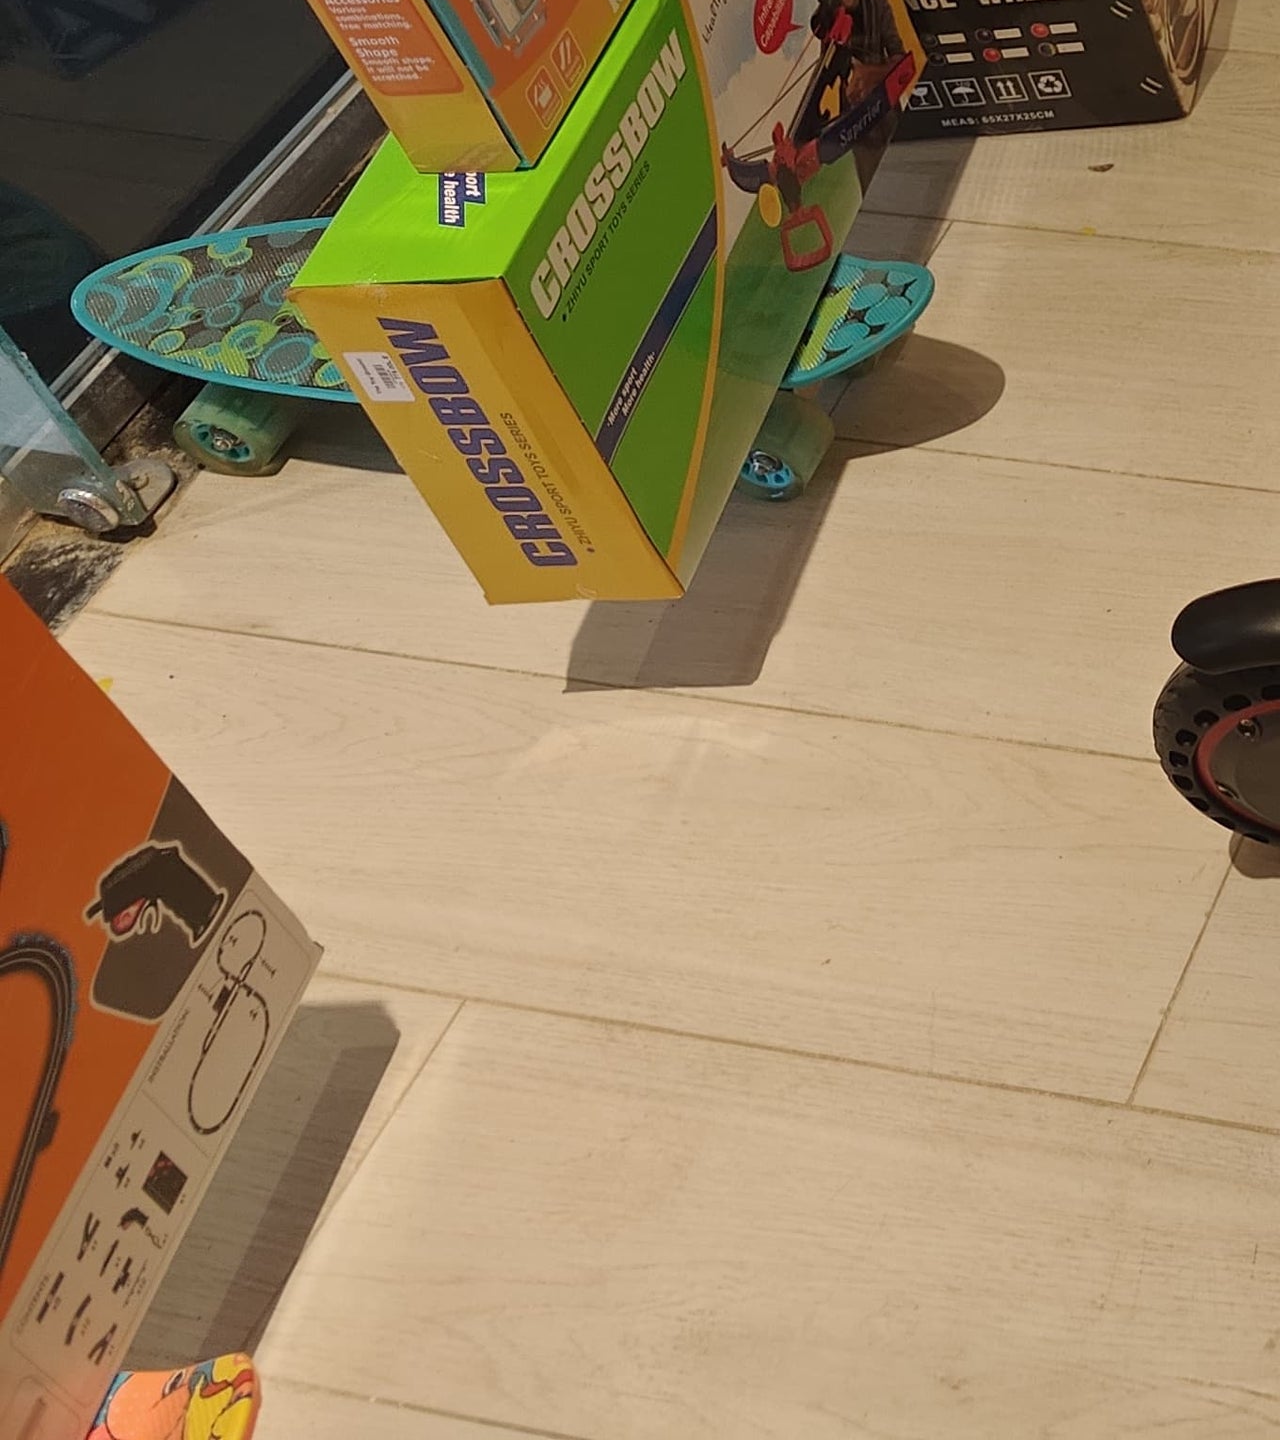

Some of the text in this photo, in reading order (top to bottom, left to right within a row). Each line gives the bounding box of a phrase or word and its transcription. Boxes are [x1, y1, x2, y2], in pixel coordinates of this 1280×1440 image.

[349, 36, 400, 46] Smooth
[355, 48, 398, 58] Shape
[838, 99, 884, 148] Superior
[941, 116, 979, 128] MEAS:
[530, 31, 689, 322] CROSSBOW
[443, 180, 460, 223] health
[586, 235, 610, 277] SPORT
[605, 201, 629, 239] TOYS
[625, 160, 652, 207] SERIES
[376, 316, 579, 567] CROSSBOW
[500, 412, 532, 454] SERIES
[524, 451, 548, 485] TOYS
[542, 482, 572, 516] SPORT
